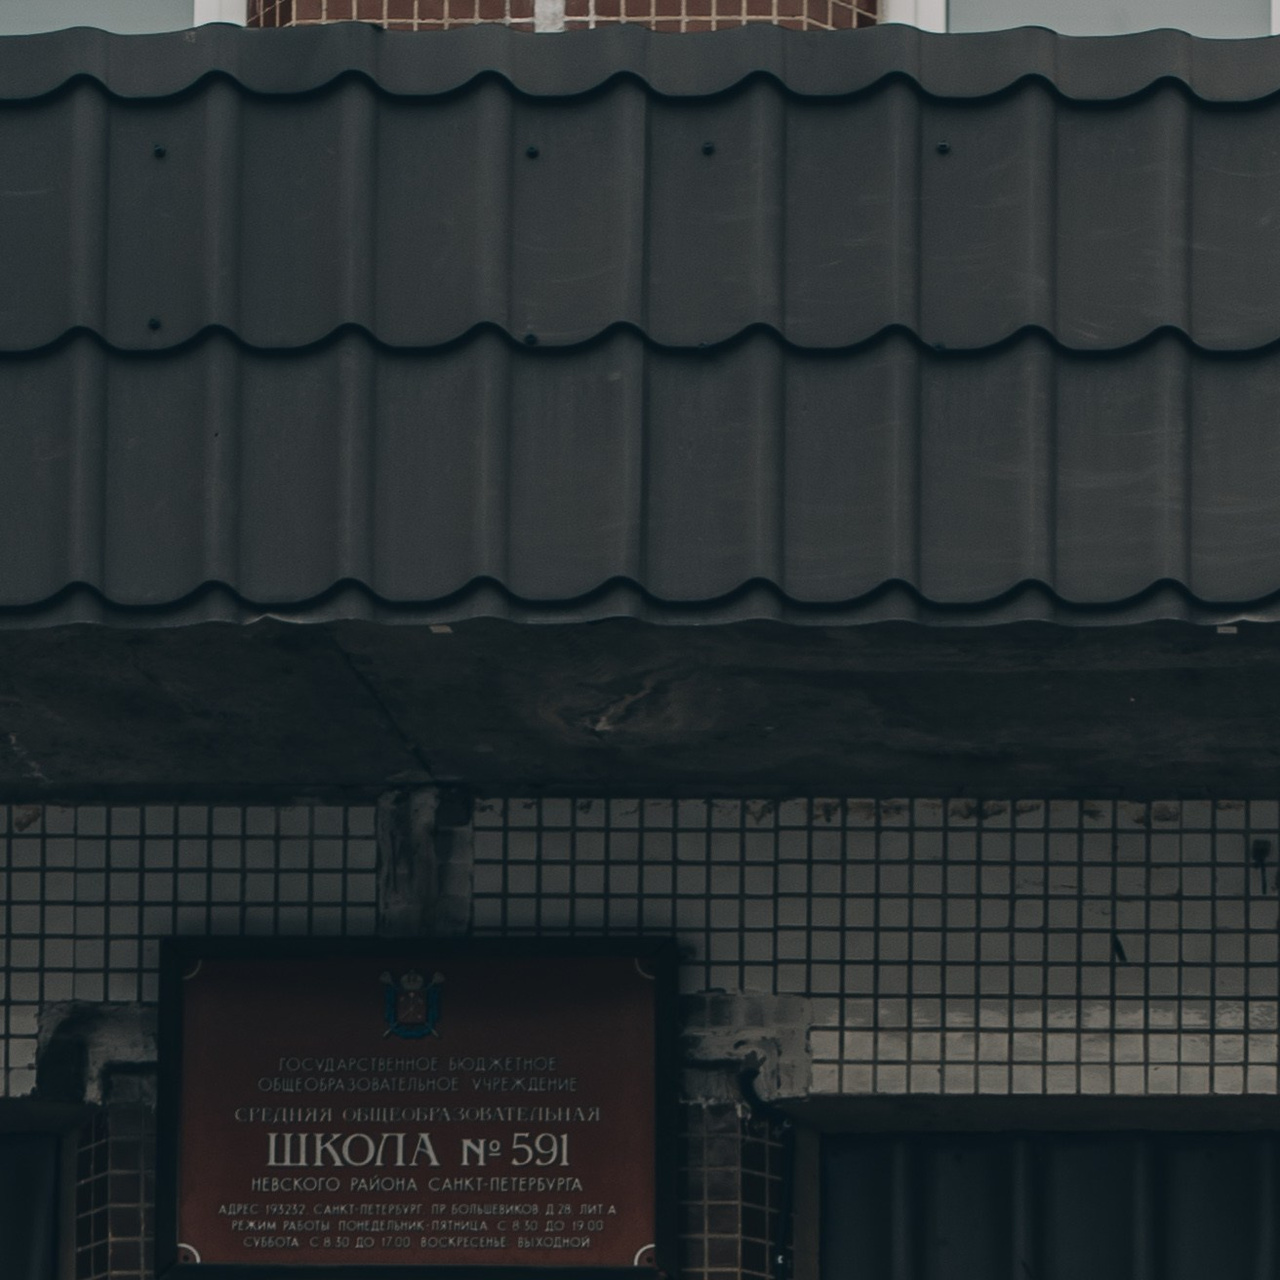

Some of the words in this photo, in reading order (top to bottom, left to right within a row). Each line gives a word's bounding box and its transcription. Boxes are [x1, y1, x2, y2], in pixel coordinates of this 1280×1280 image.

[279, 1057, 438, 1072] ГОСУДАРСТВЕННОЕ
[449, 1056, 556, 1071] БЮДЖЕТНОЕ
[258, 1077, 459, 1092] ОБЩЕОБРАЗОВАТЕЛЬНОЕ
[472, 1076, 578, 1092] УЧРЕЖДЕНИЕ
[234, 1106, 332, 1123] СРЕДНЯЯ
[342, 1106, 600, 1123] ОБЩЕОБРАЗОВАТЕЛЬНАЯ
[266, 1132, 440, 1166] ШКОЛА
[460, 1138, 501, 1166] №
[511, 1132, 570, 1166] 591
[251, 1177, 340, 1192] НЕВСКОГО
[350, 1174, 418, 1191] РАЙОНА
[428, 1177, 583, 1192] САНКТ-ПЕТЕРБУРГА
[607, 1204, 617, 1215] А
[232, 1220, 277, 1231] РЕЖИМ
[497, 1220, 507, 1231] С
[545, 1220, 565, 1232] ДО
[243, 1236, 299, 1248] СУББОТА
[309, 1236, 319, 1248] С
[355, 1236, 375, 1249] ДО
[420, 1236, 506, 1248] ВОСКРЕСЕНЬЕ
[518, 1235, 590, 1248] ВЫХОДНОЙ
